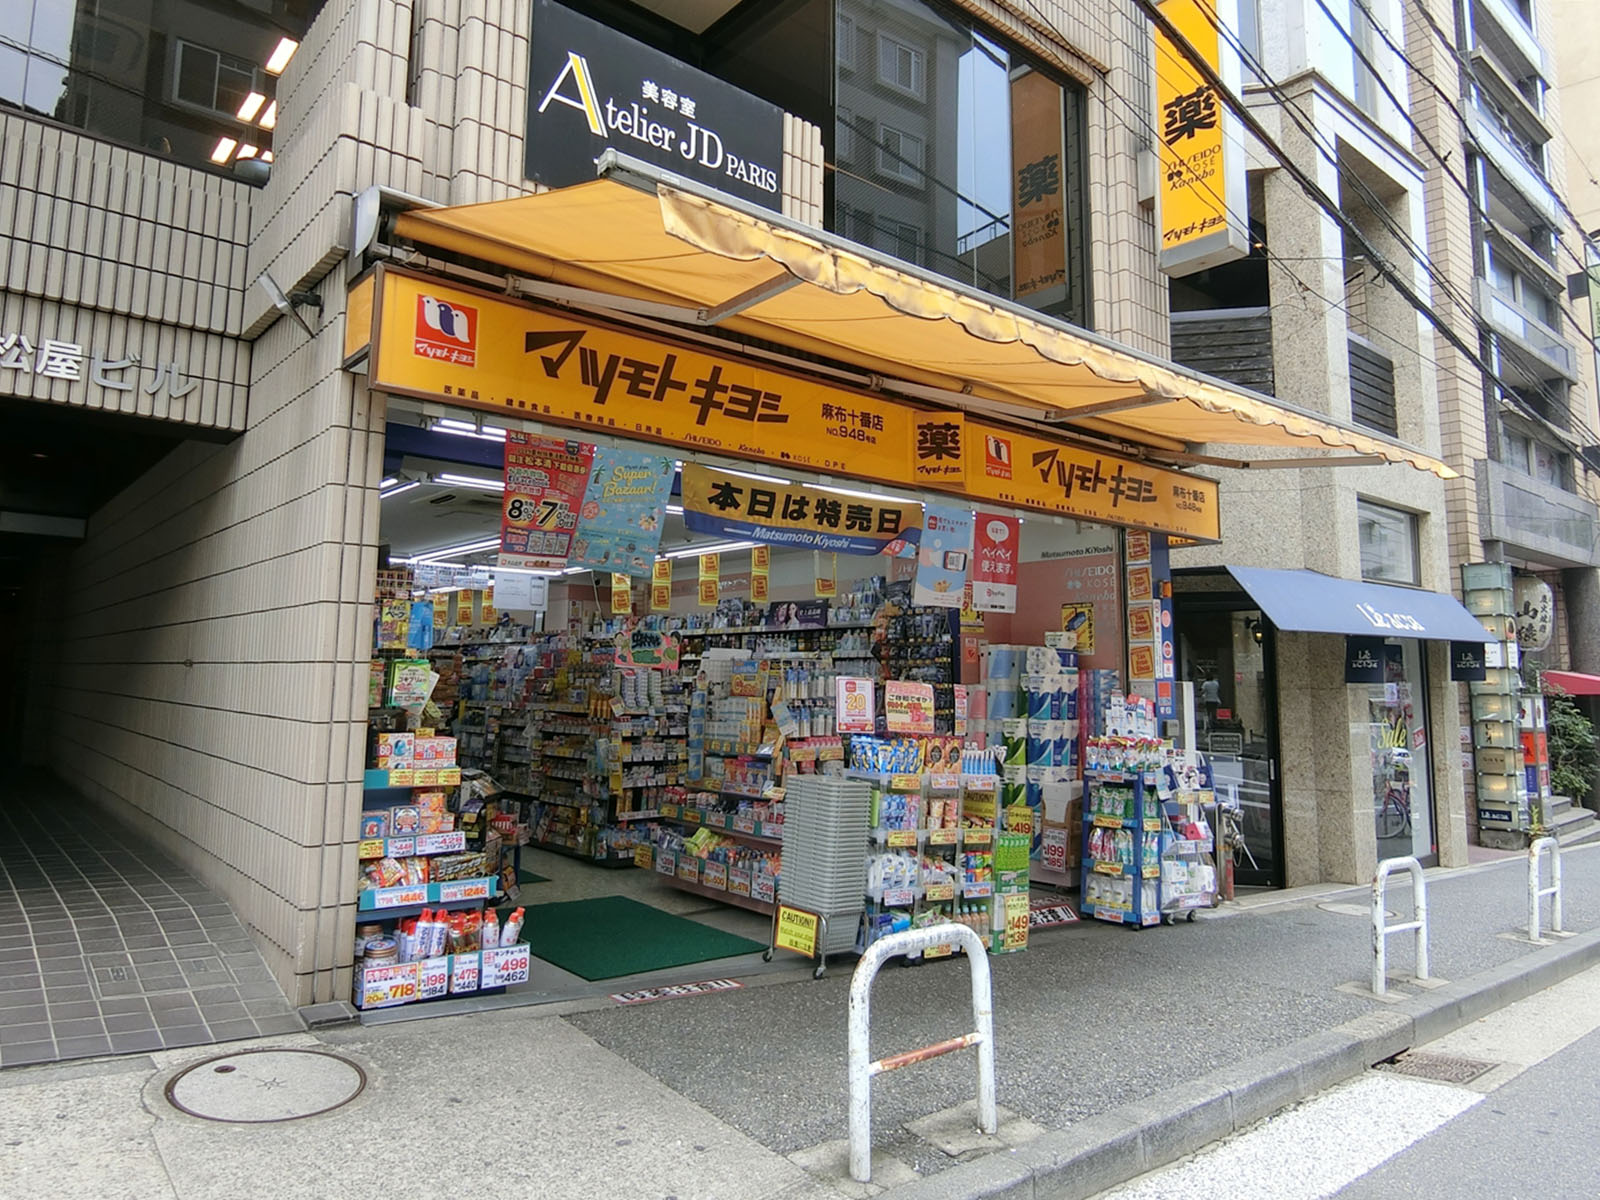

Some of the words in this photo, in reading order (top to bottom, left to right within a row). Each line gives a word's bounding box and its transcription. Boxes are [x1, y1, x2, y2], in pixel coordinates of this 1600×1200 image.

[641, 80, 697, 119] 美容室
[538, 51, 676, 152] Atelier
[680, 122, 724, 170] JD
[725, 153, 778, 194] PARIS
[1163, 85, 1218, 147] 薬
[1163, 215, 1226, 242] マツモトキヨシ
[416, 341, 475, 364] マツモトキヨシ
[525, 330, 789, 426] マツモトキヨシ
[821, 403, 883, 432] 麻布十番店
[917, 422, 960, 460] 薬
[612, 466, 651, 486] Super
[917, 465, 962, 475] マツモトキヨシ
[1032, 449, 1157, 507] マツモトキヨシ
[708, 481, 902, 534] 本日は特売日
[752, 527, 812, 545] Matsumoto
[813, 531, 851, 549] Kiyoshi
[846, 693, 866, 711] 20
[1013, 822, 1032, 834] 419
[440, 836, 463, 846] 428
[1047, 844, 1064, 857] 199
[400, 892, 425, 903] 1446
[464, 886, 487, 897] 1246
[1012, 915, 1028, 930] 149
[501, 957, 528, 971] 498
[426, 973, 446, 987] 198
[458, 968, 478, 980] 475
[504, 971, 526, 982] 462
[389, 983, 415, 998] 718
